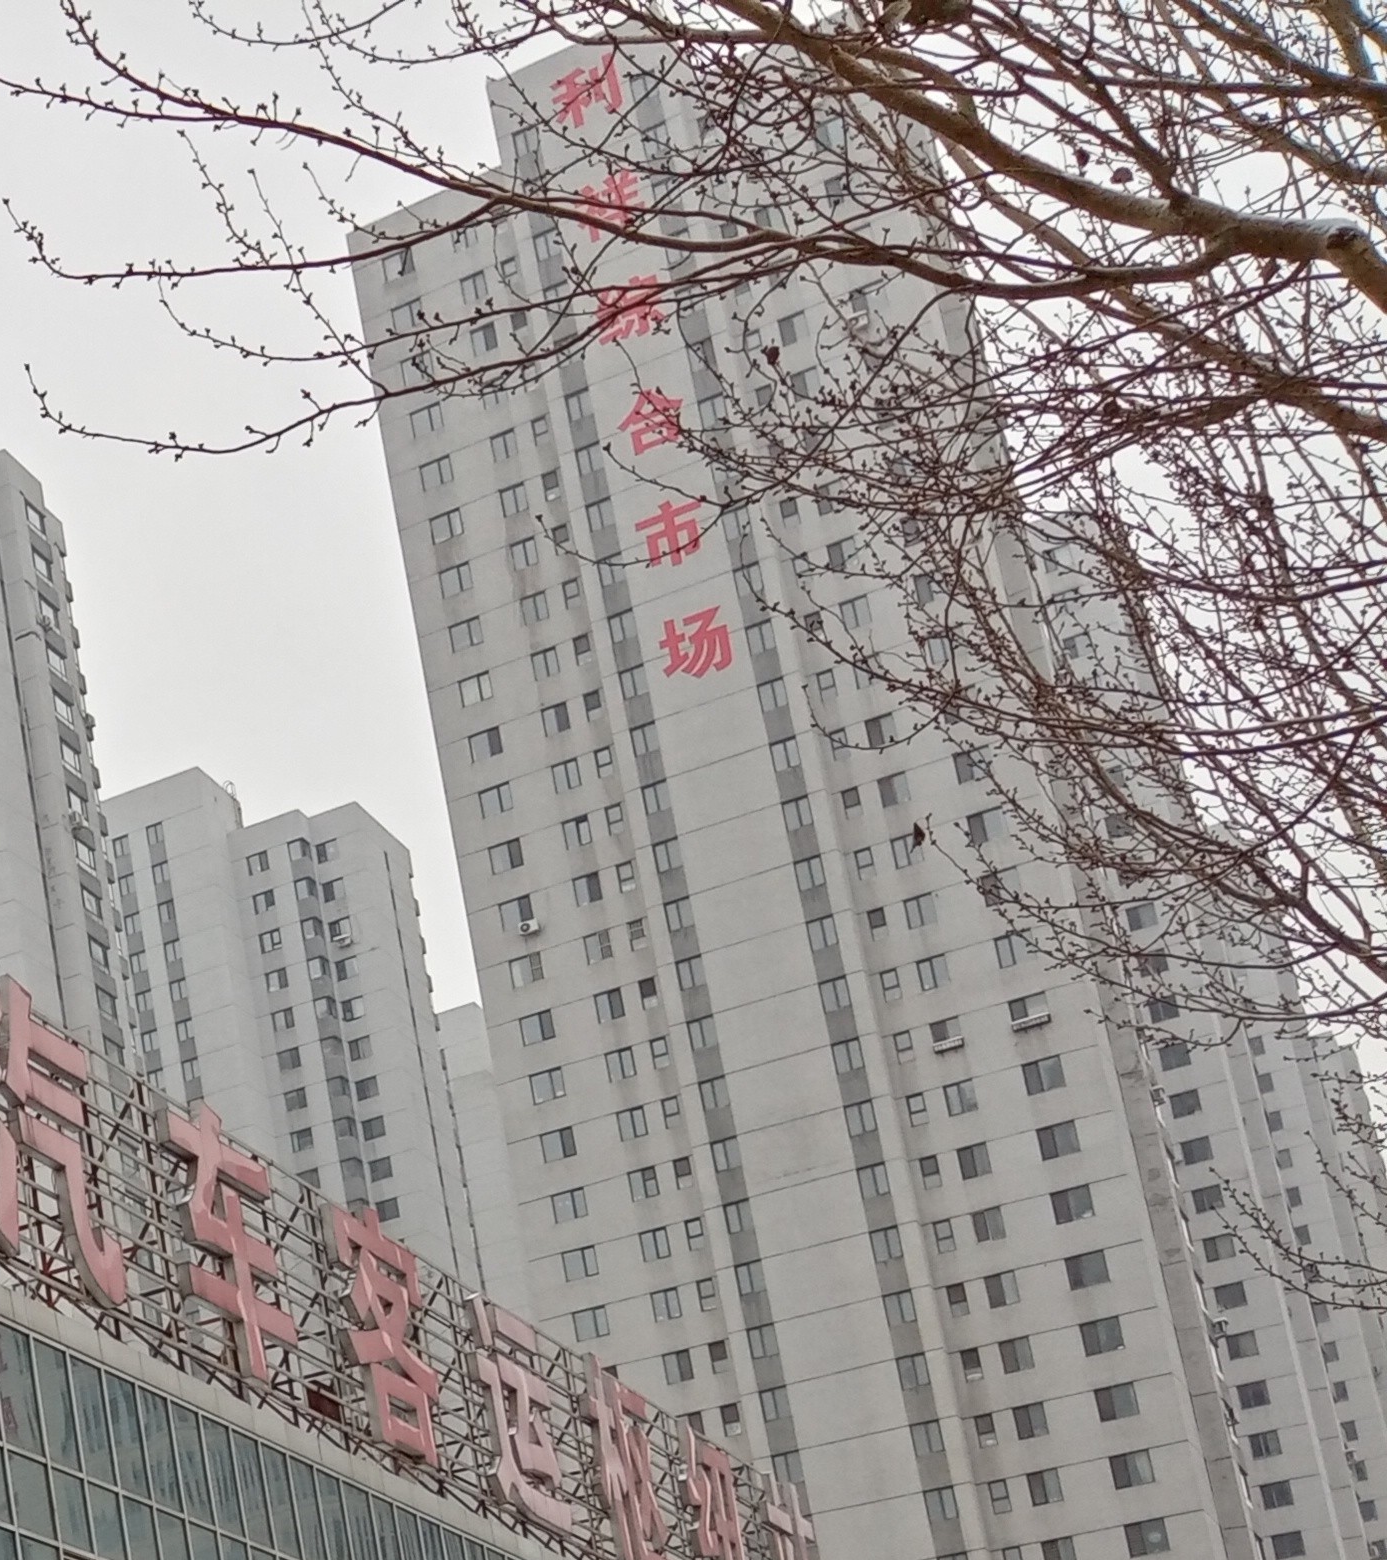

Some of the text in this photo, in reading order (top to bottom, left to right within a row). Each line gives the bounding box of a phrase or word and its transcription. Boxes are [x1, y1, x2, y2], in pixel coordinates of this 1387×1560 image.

[550, 54, 733, 678] 利祥综合市场
